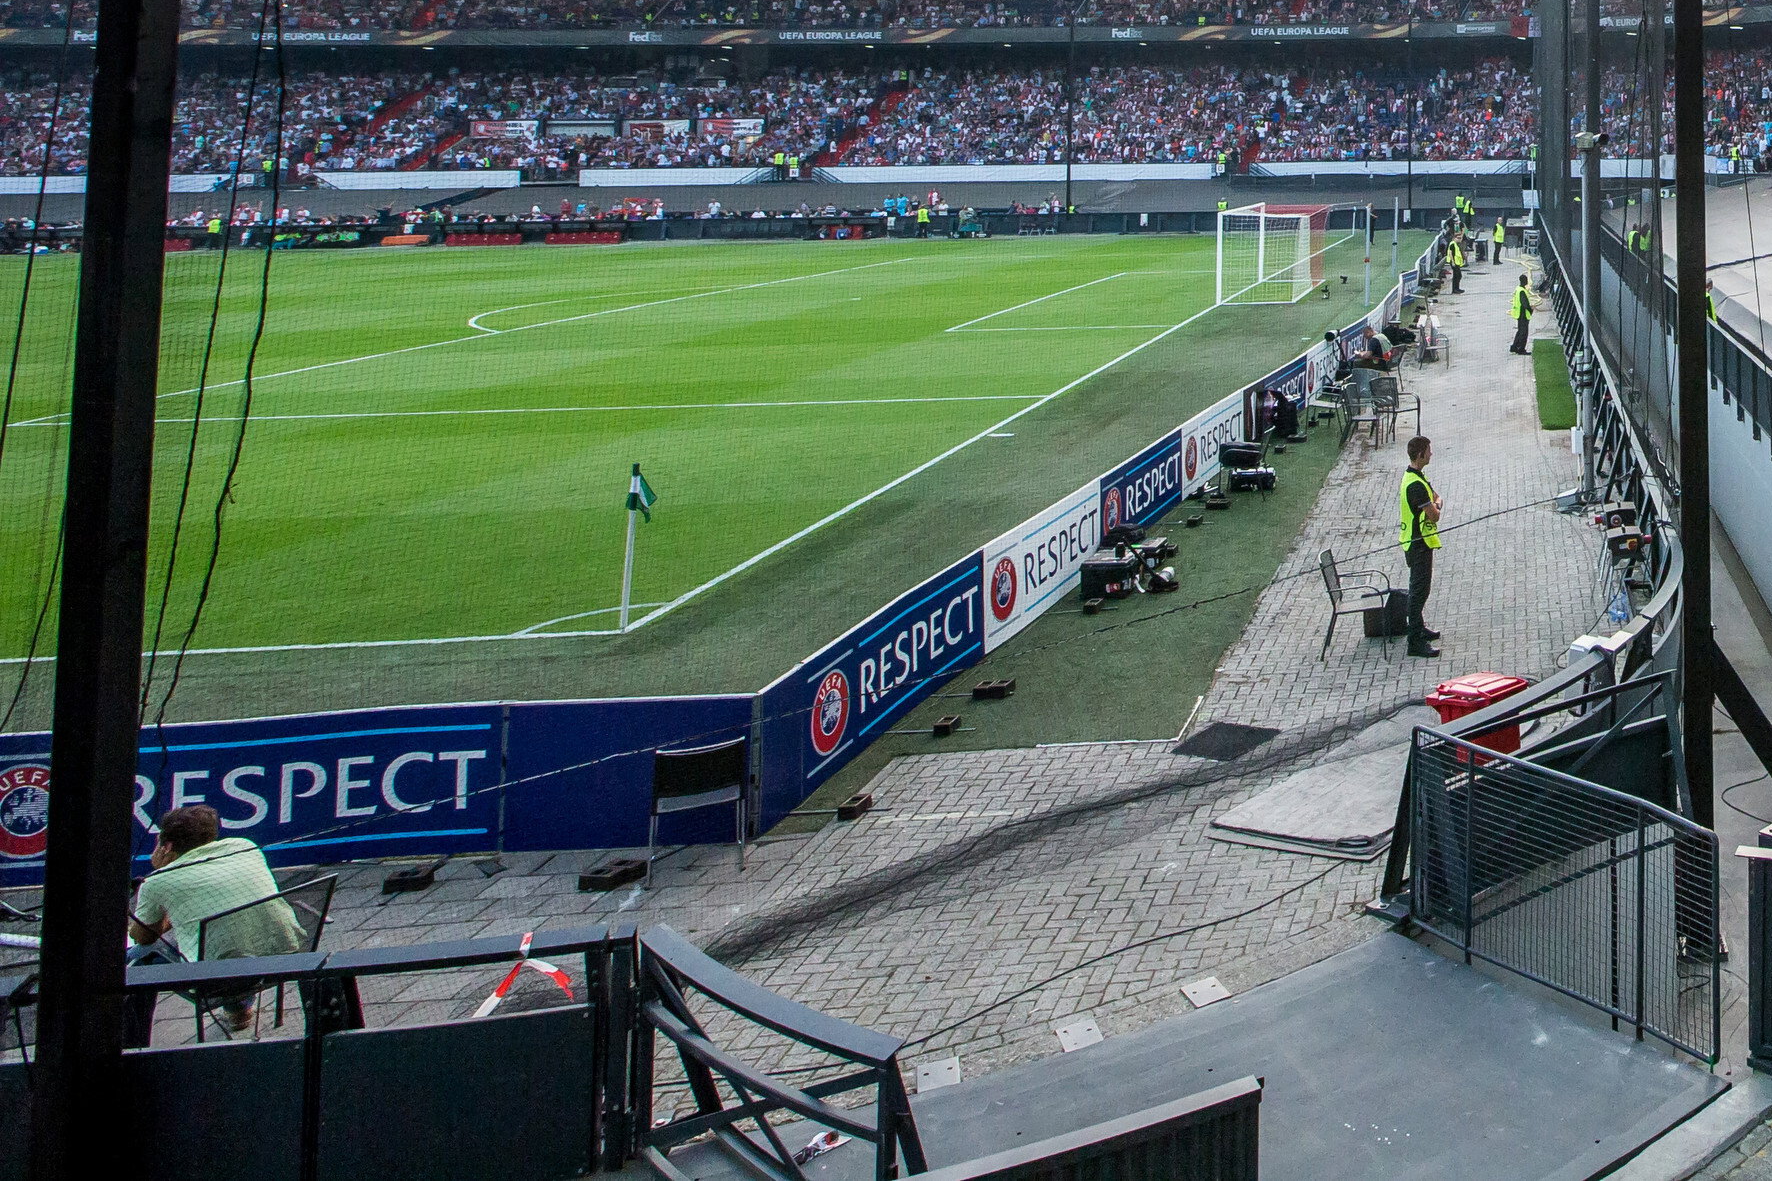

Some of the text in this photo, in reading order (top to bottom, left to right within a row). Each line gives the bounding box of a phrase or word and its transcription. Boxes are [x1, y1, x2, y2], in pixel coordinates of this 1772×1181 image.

[283, 32, 326, 41] EUROPA
[328, 32, 371, 41] LEAGUE
[779, 31, 882, 40] UEFA EUROPA LEAGUE
[1251, 26, 1349, 36] UEFA EUROPA LEAGUE
[1126, 451, 1181, 521] RESPECT
[1023, 508, 1098, 595] RESPECT
[995, 562, 1012, 579] UEFA
[860, 585, 978, 714] RESPECT
[818, 674, 842, 701] UEFA
